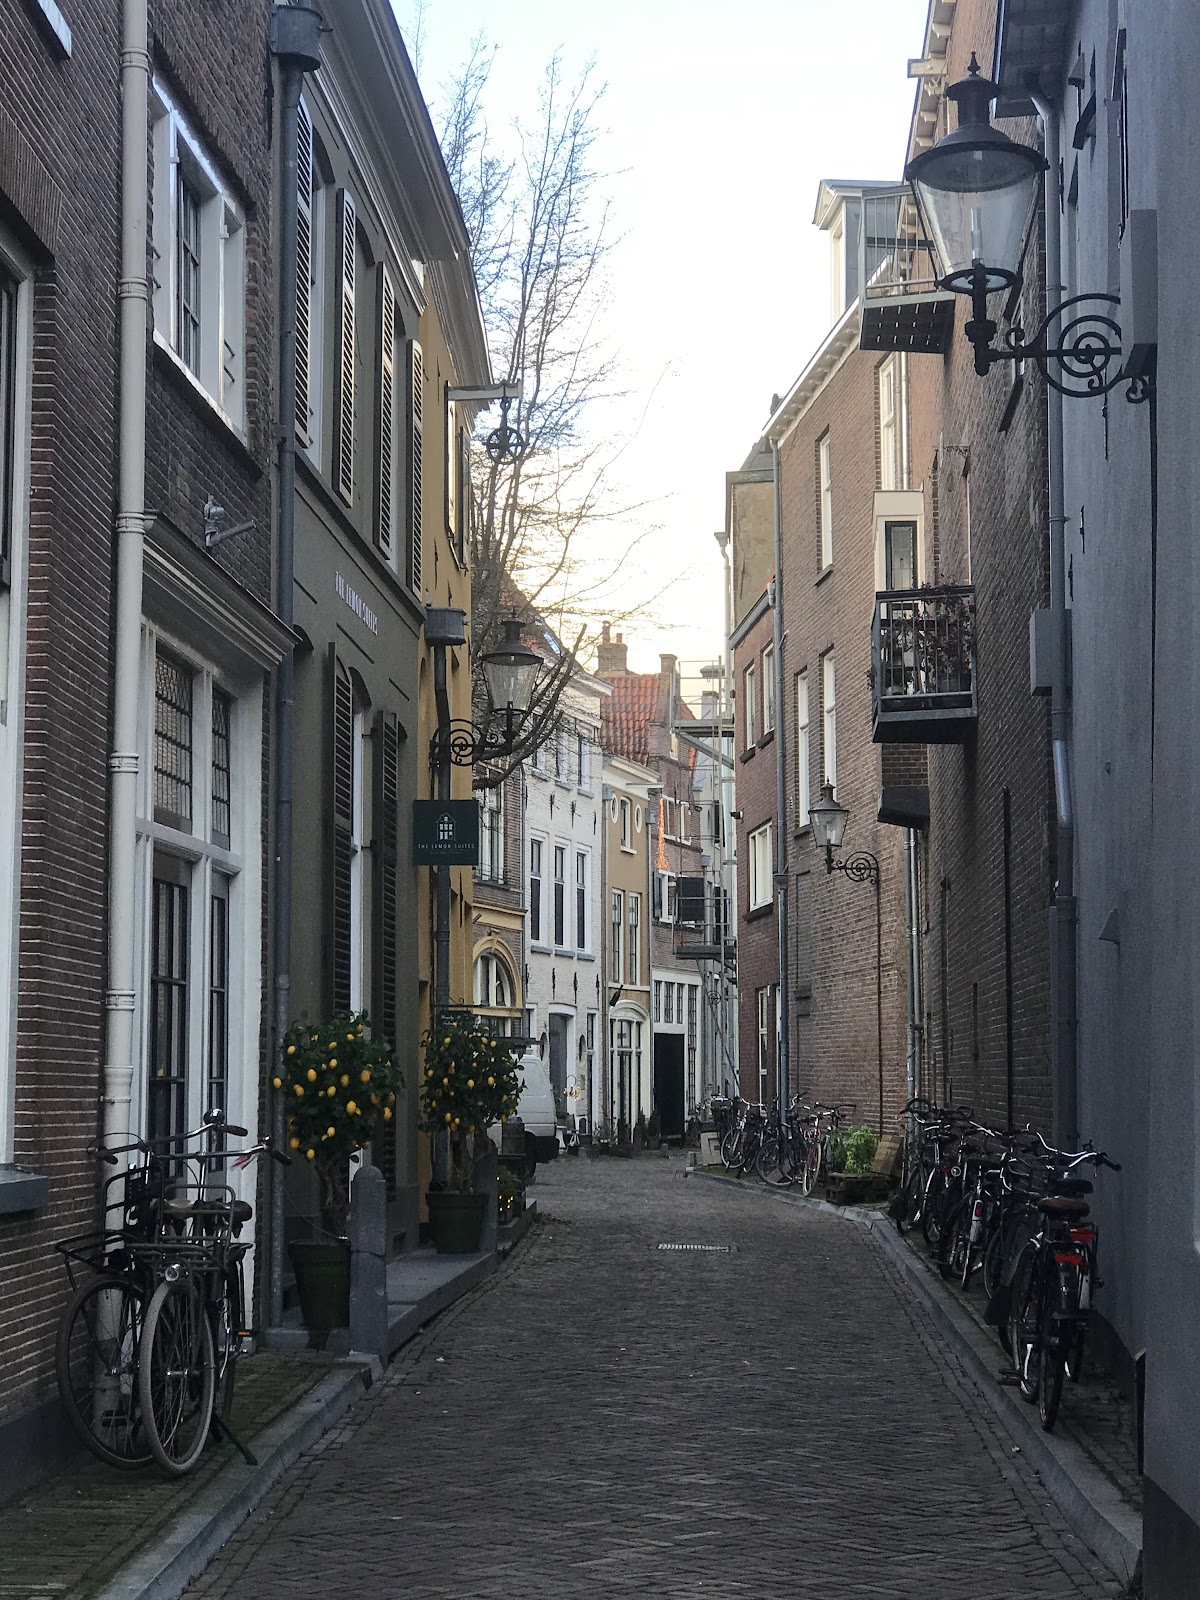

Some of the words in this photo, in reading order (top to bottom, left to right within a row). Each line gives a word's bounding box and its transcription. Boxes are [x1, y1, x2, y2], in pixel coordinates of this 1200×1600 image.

[335, 571, 344, 600] THE
[346, 584, 362, 618] LEMON
[363, 602, 378, 636] SUITES
